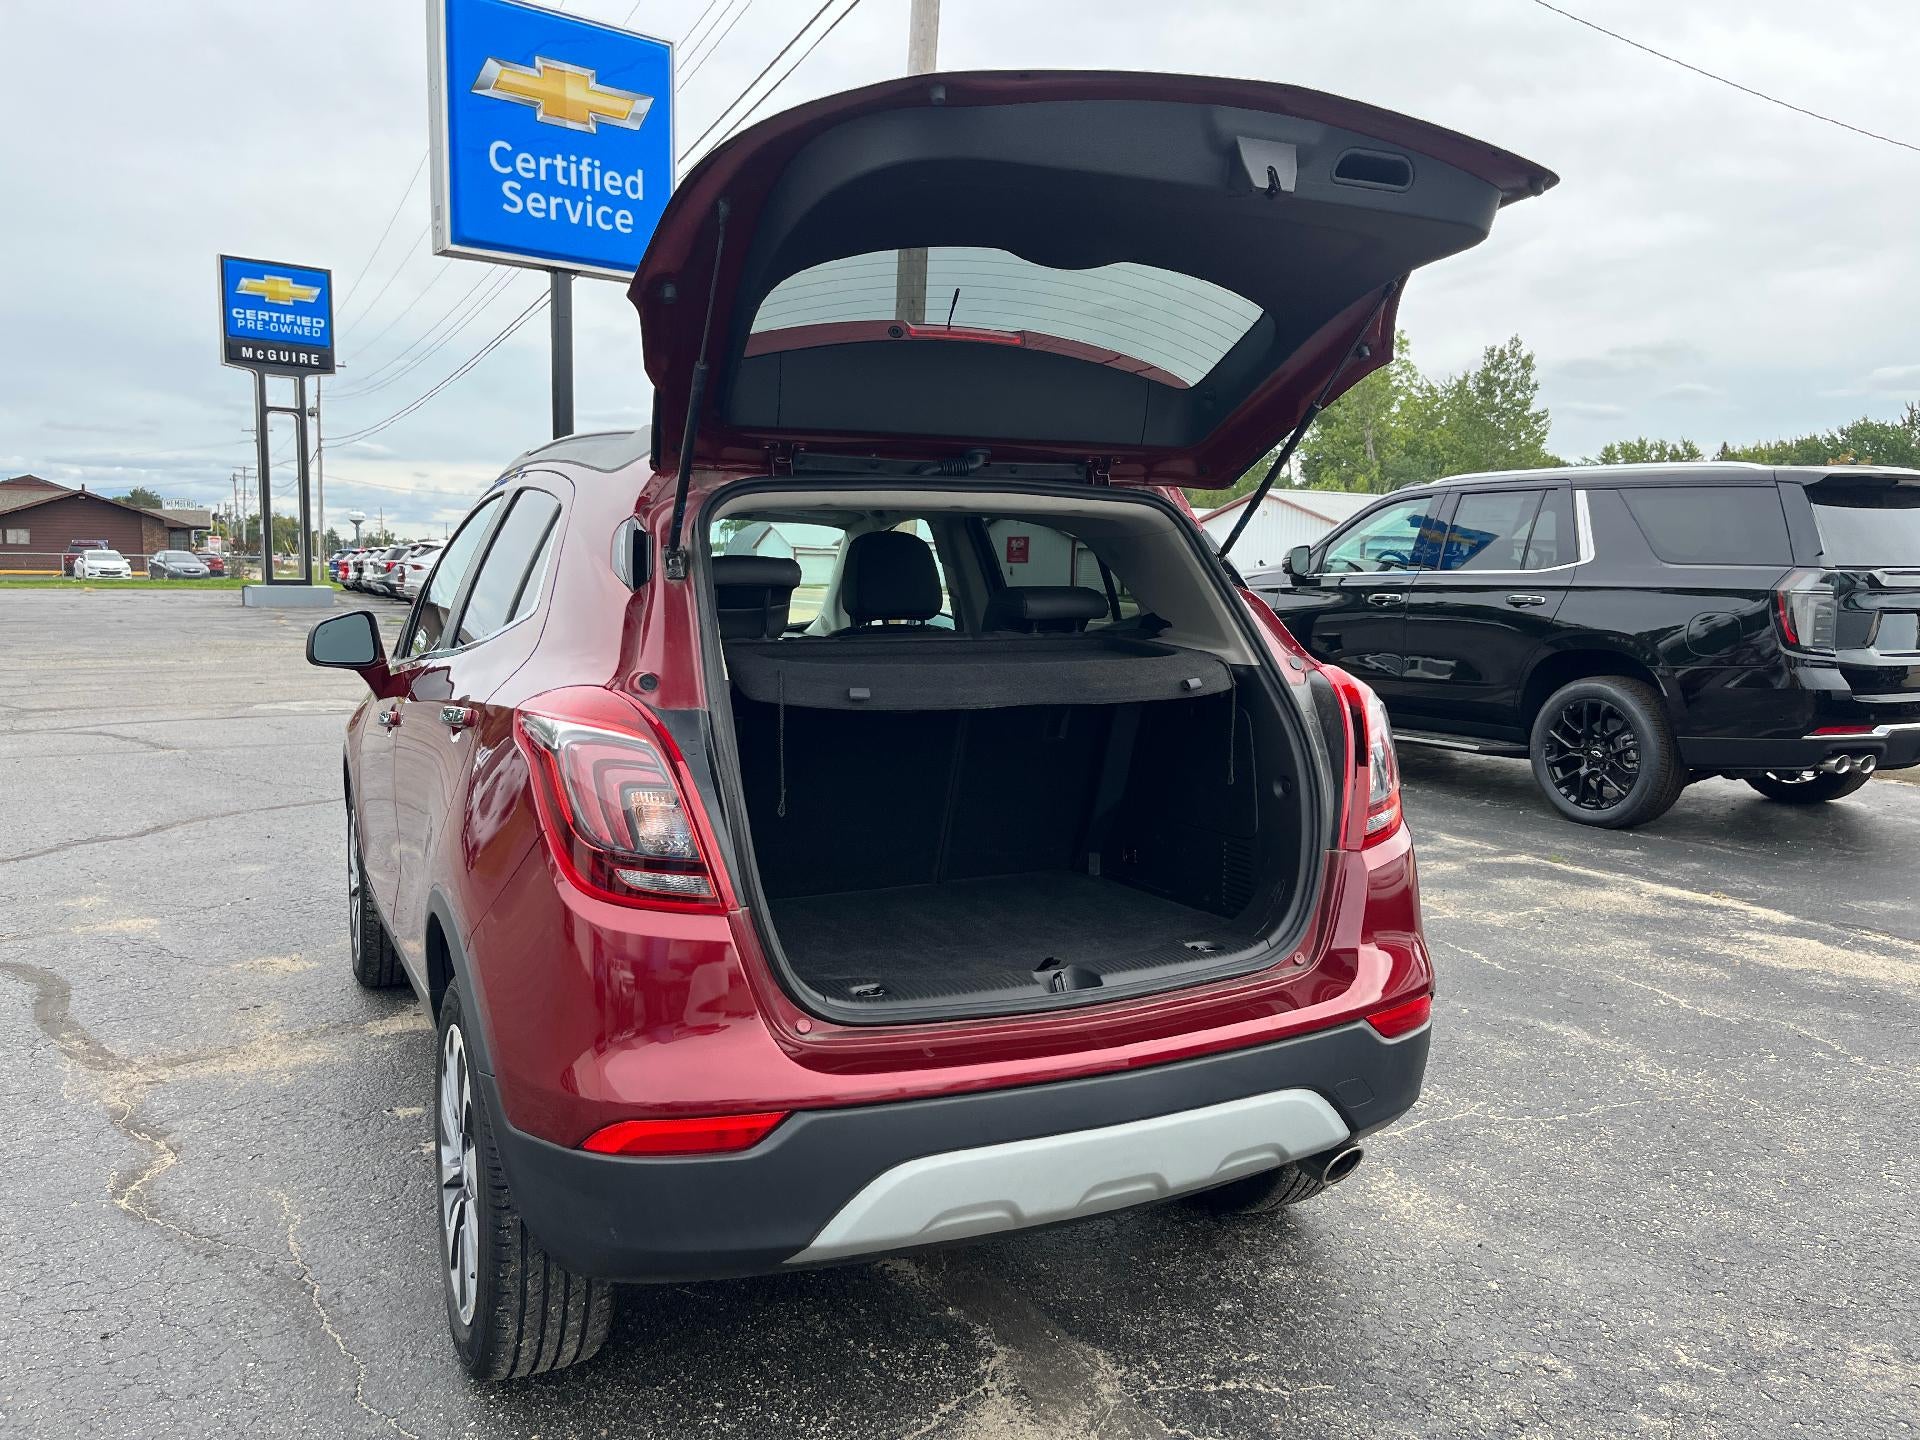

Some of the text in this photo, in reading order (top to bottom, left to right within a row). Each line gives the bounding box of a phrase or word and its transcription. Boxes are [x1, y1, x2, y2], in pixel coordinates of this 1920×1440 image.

[488, 140, 644, 201] Certified
[501, 180, 634, 234] Service
[231, 307, 325, 329] CERTIFIED
[237, 318, 321, 337] PRE-OWNED
[241, 346, 320, 366] McGUIRE
